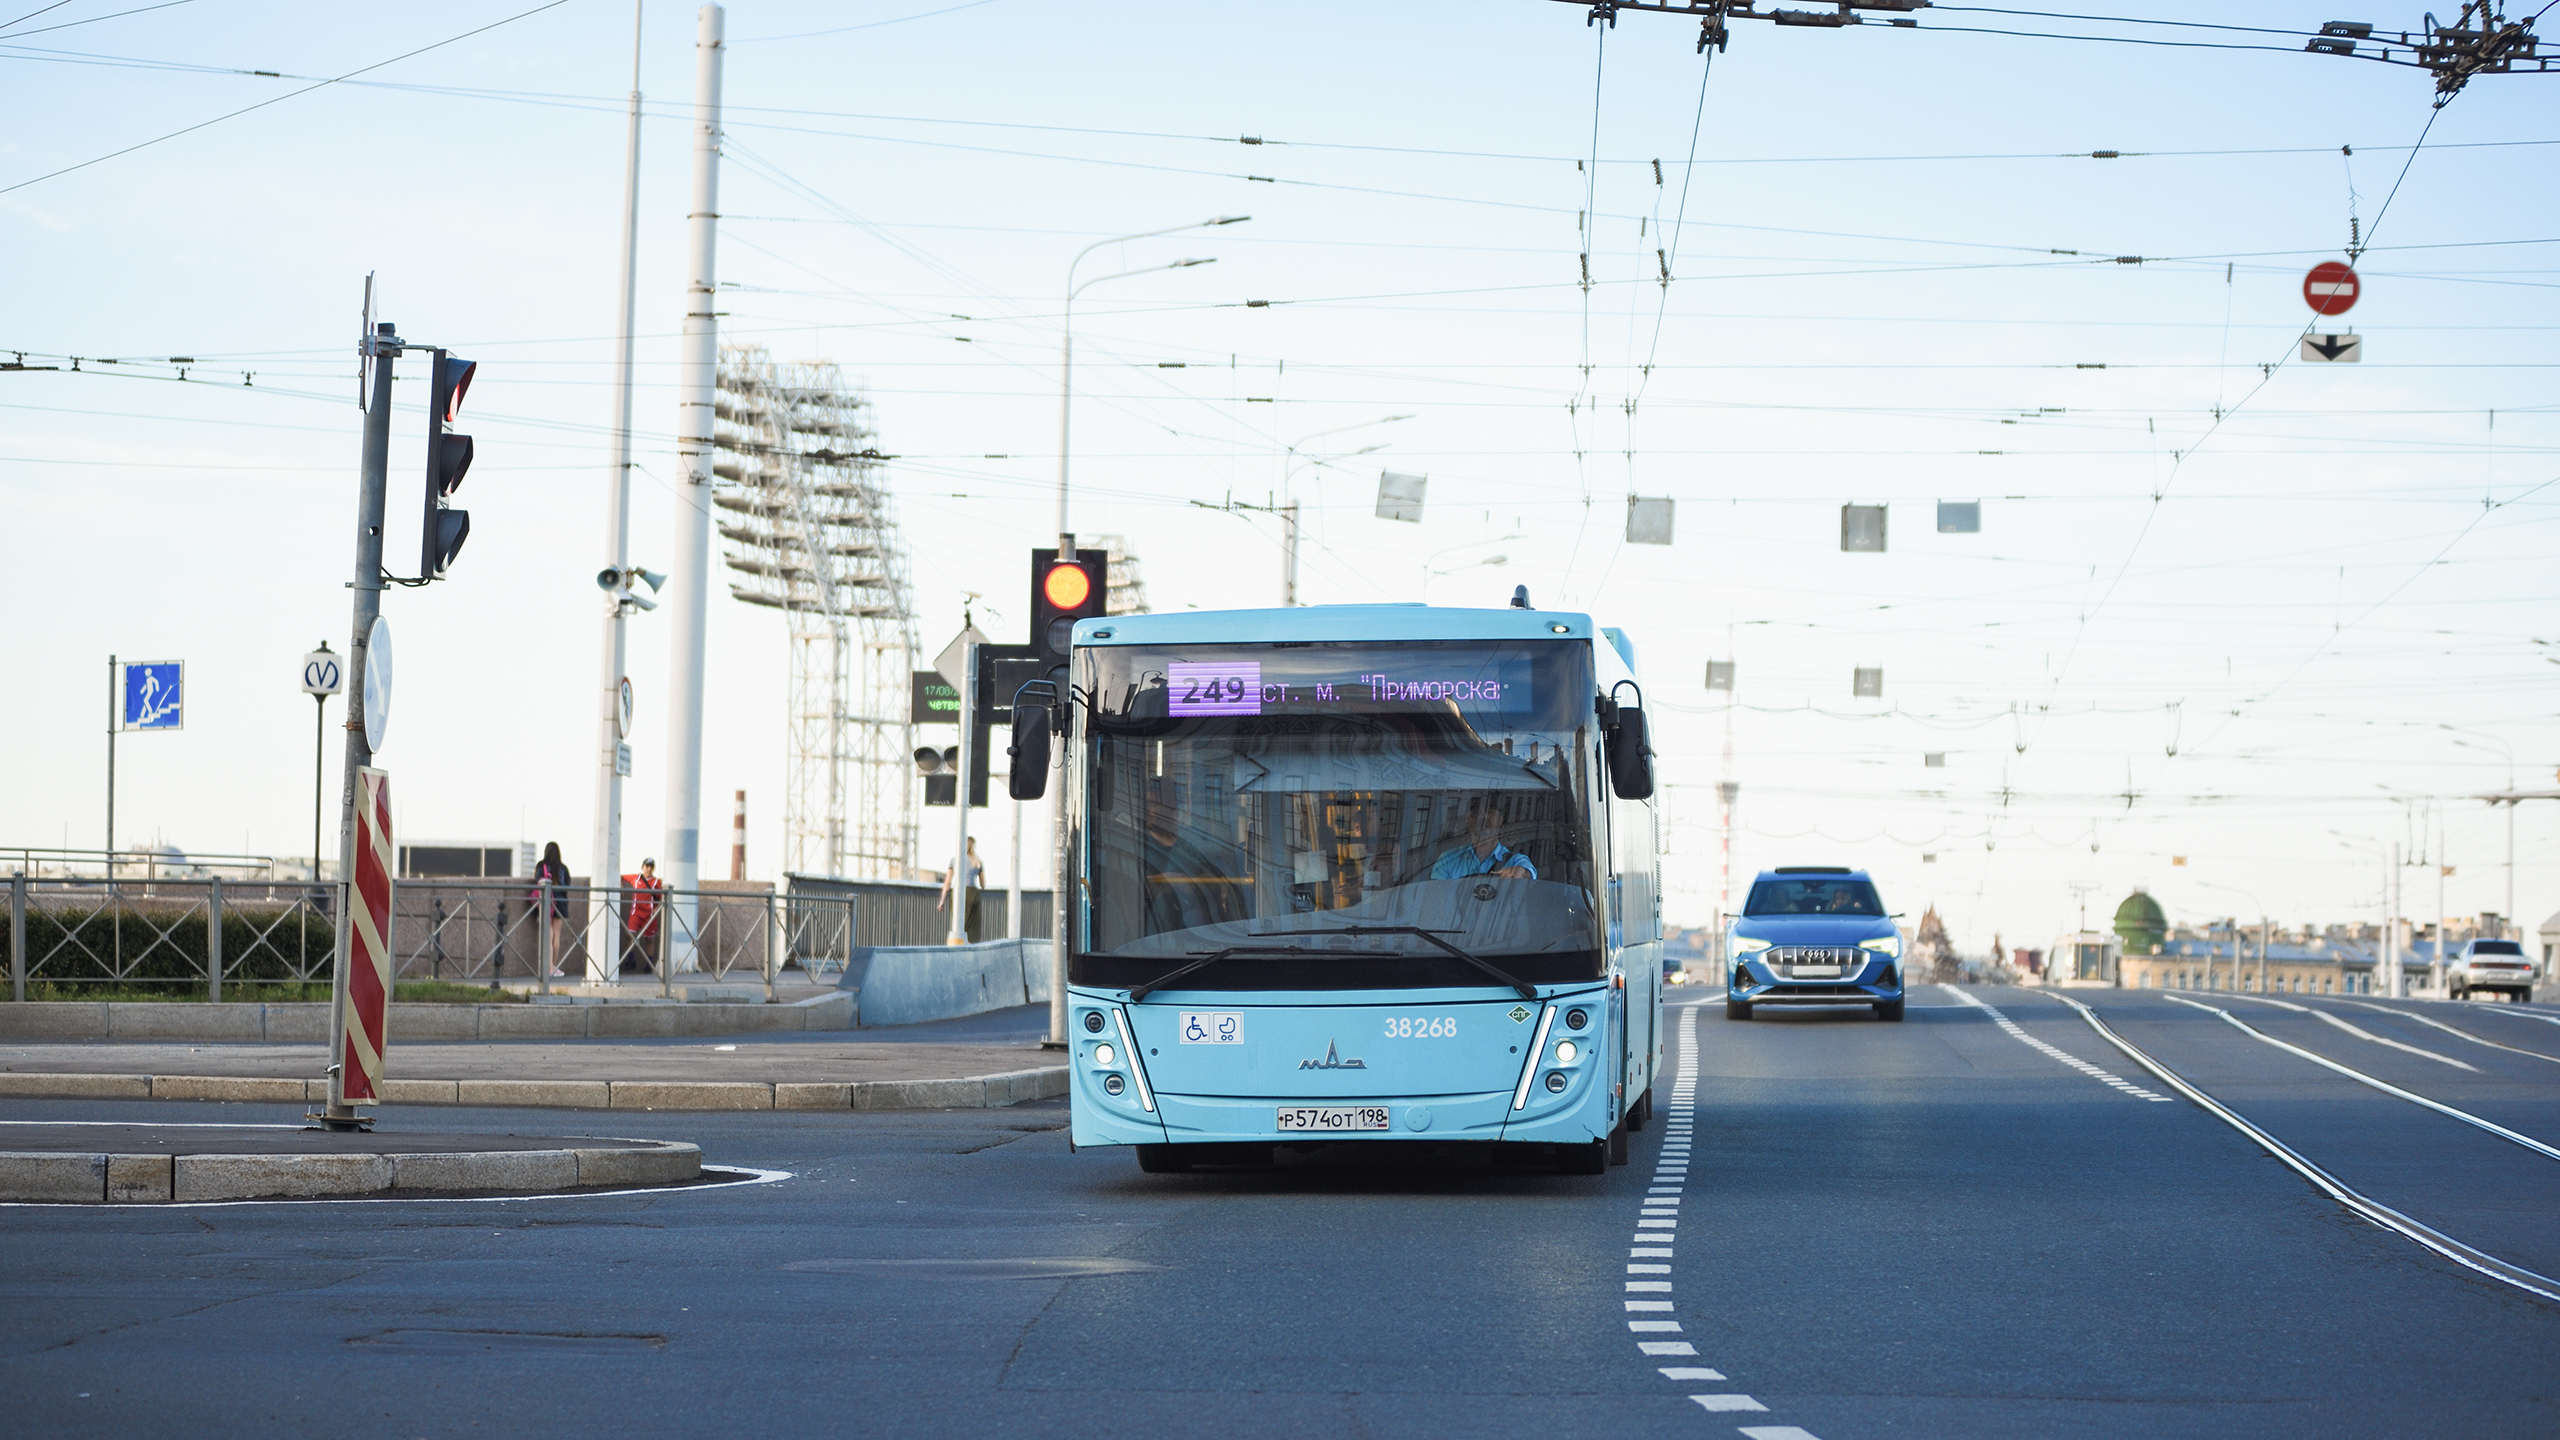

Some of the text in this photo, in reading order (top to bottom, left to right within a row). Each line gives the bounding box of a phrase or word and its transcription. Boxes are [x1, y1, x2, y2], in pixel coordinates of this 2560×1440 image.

[1181, 676, 1246, 704] 249
[1361, 674, 1501, 702] "Приморска
[1384, 1017, 1458, 1038] 38268
[1357, 1108, 1384, 1123] 198
